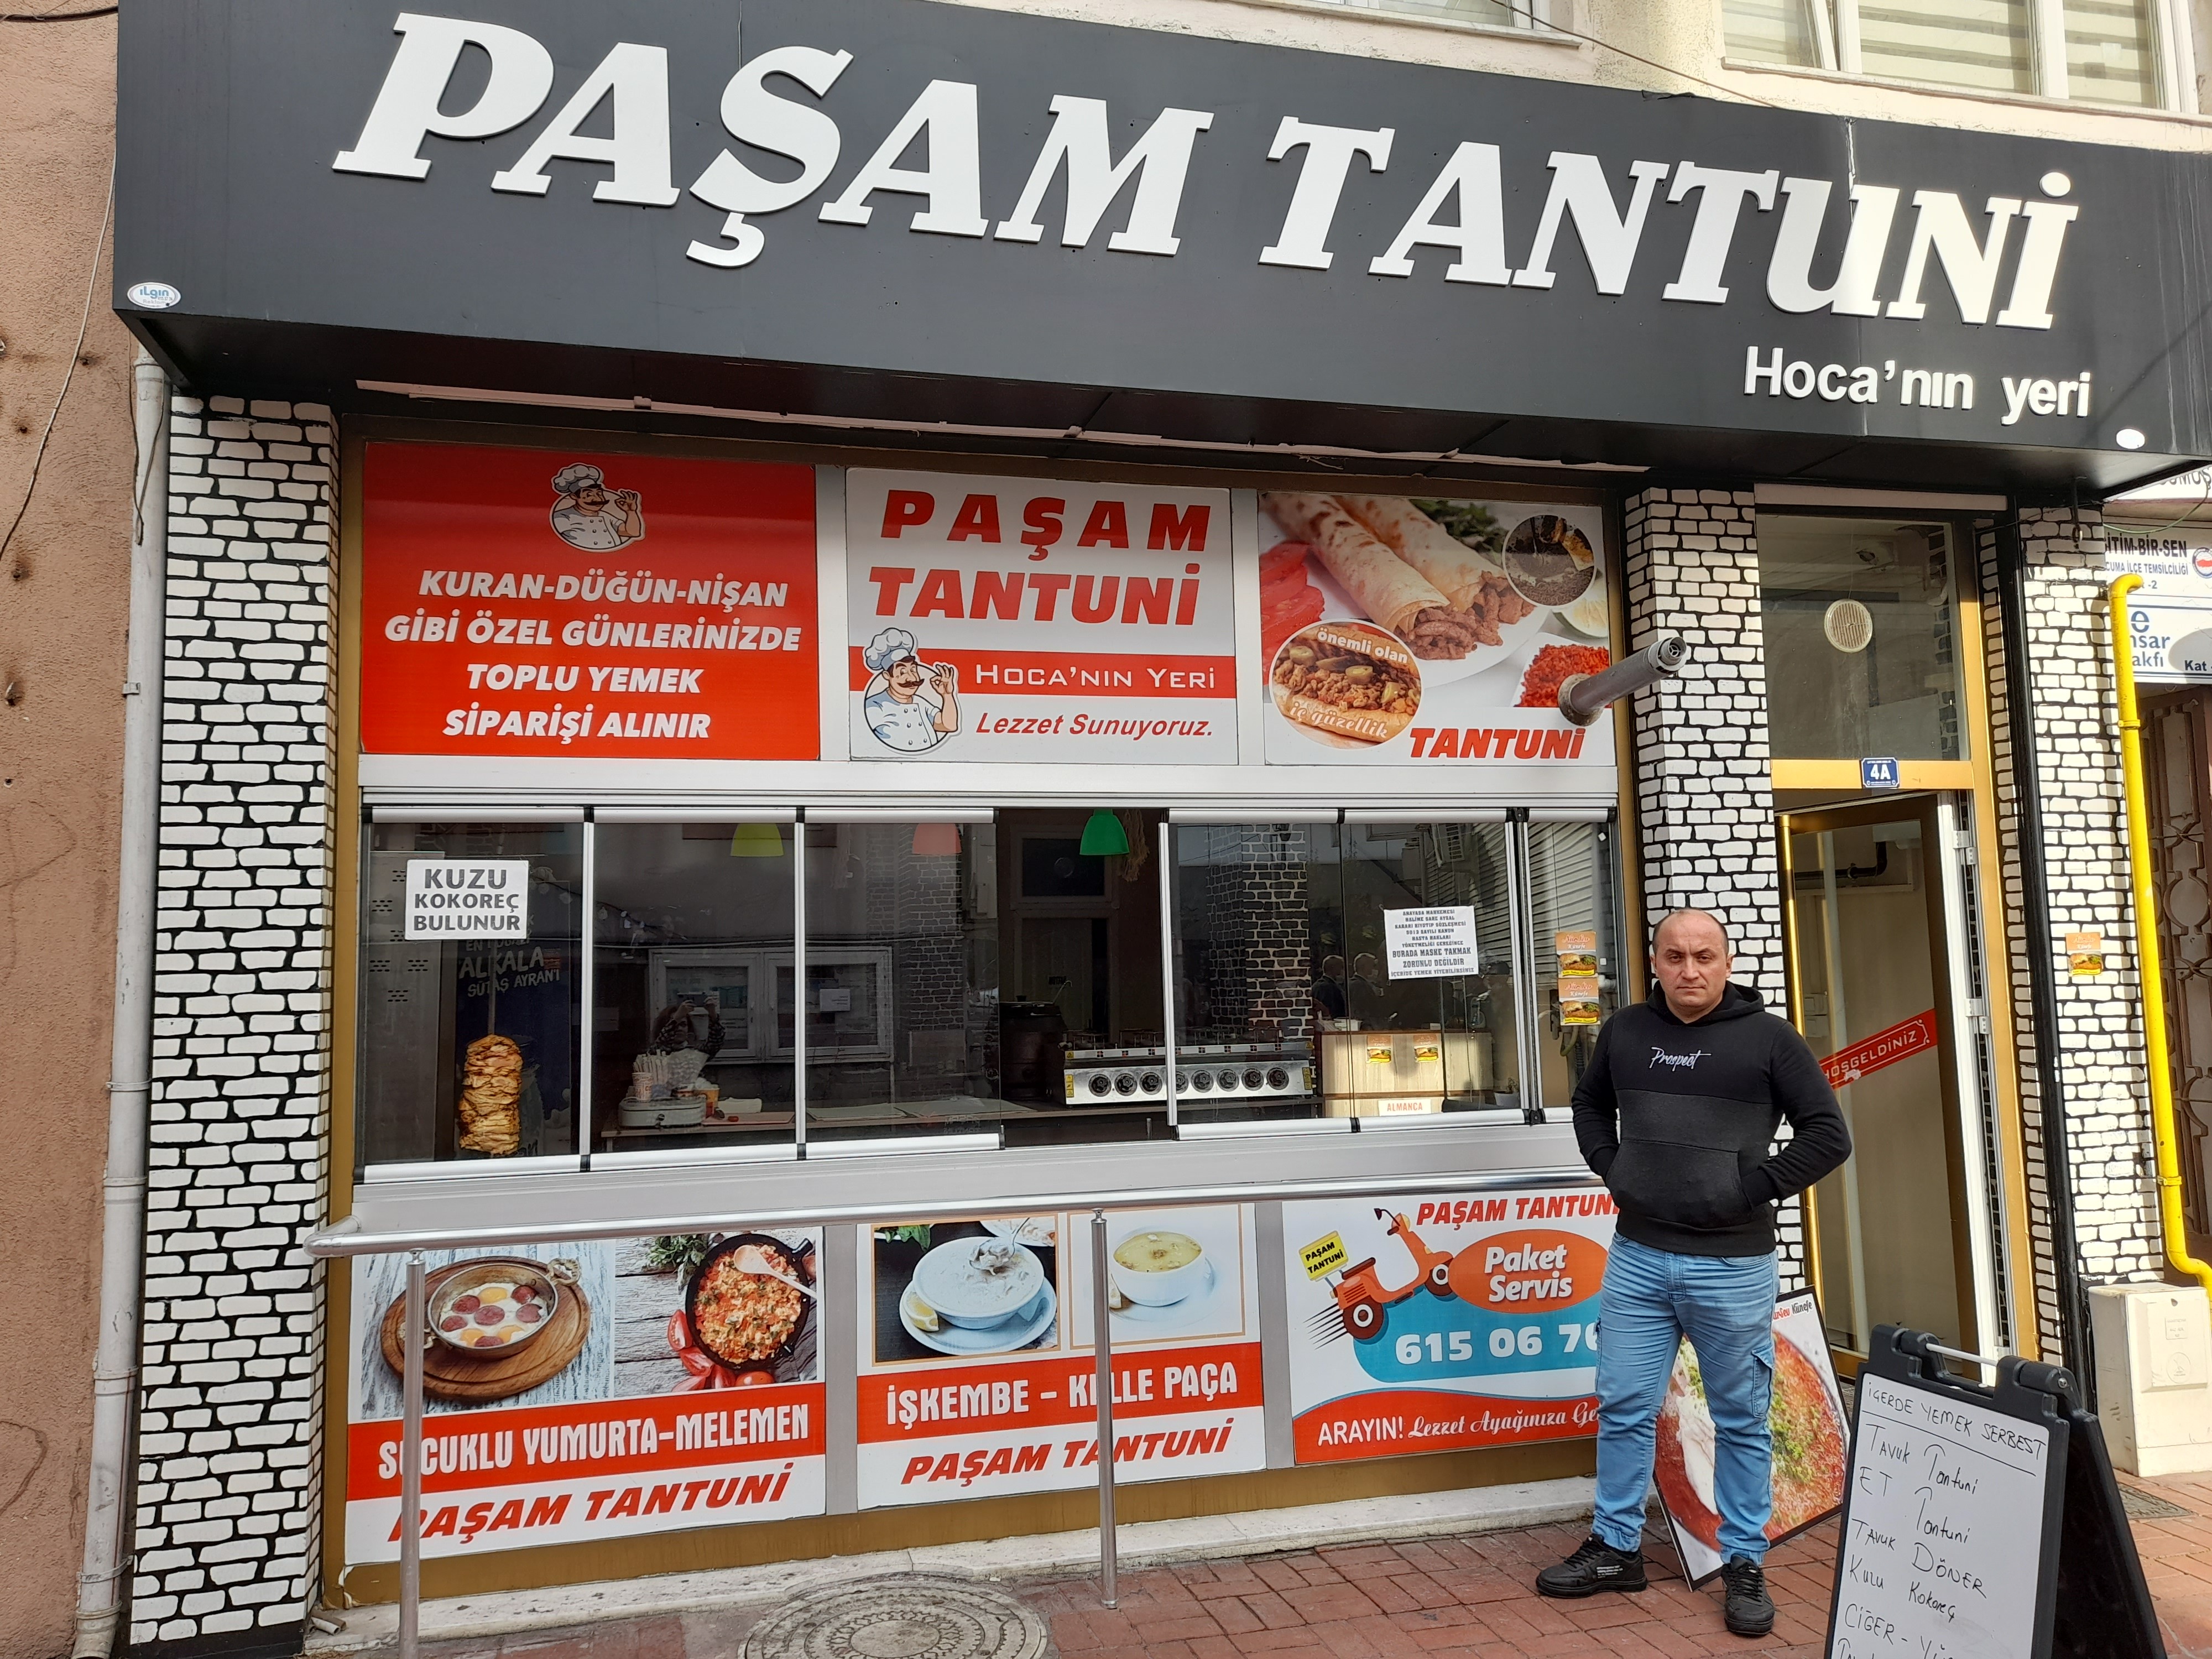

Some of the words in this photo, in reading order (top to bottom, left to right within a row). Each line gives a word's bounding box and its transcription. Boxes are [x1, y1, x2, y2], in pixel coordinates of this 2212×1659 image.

[332, 11, 1215, 268] PAŞAM
[1258, 115, 2080, 330] TANTUNİ
[1743, 345, 1974, 411] Hoca'nın
[2000, 371, 2092, 427] yeri
[880, 489, 1211, 561] PAŞAM
[2106, 532, 2188, 558] İTİM-BİR-SEN
[2127, 560, 2142, 575] İLÇE
[419, 567, 788, 613] KURAN-DÜĞÜN-NİŞAN
[869, 563, 1200, 625] TANTUNİ
[385, 608, 460, 644] GİBİ
[466, 609, 553, 646] ÖZEL
[561, 614, 802, 651] GÜNLERİNİZDE
[1317, 627, 1372, 656] önemli
[1373, 643, 1408, 664] olan
[466, 664, 579, 692] TOPLU
[588, 666, 705, 694] YEMEK
[2184, 660, 2207, 671] Kat
[442, 701, 593, 745] SİPARİŞİ
[597, 712, 711, 739] ALINIR
[976, 712, 1063, 734] Lezzet
[1070, 713, 1213, 742] Sunuyoruz.
[1290, 701, 1308, 723] iç
[1310, 706, 1388, 739] güzellik
[1410, 727, 1585, 759] TANTUNİ
[1870, 764, 1891, 780] 4A
[424, 868, 507, 889] KUZU
[415, 893, 519, 914] KOKOREÇ
[414, 915, 520, 931] BULUNUR
[1392, 950, 1418, 958] BURADA
[1403, 959, 1432, 968] ZORUNLU
[1434, 957, 1464, 966] DEĞİLDİR
[1386, 1101, 1423, 1112] ALMANCA
[1416, 1199, 1508, 1230] PAŞAM
[1515, 1193, 1619, 1220] TANTUN
[1306, 1241, 1335, 1261] PAŞAM
[1307, 1249, 1344, 1274] TANTUNİ
[1484, 1243, 1567, 1274] Paket
[1489, 1271, 1573, 1302] Servis
[1395, 1331, 1473, 1365] 615
[1489, 1326, 1542, 1358] 06
[887, 1380, 1029, 1431] İŞKEMBE
[1164, 1361, 1237, 1402] PAÇA
[379, 1431, 513, 1480] SCUKLU
[523, 1403, 808, 1465] YUMURTA-MELEMEN
[1318, 1416, 1404, 1447] ARAYIN!
[1408, 1413, 1465, 1438] Lezzet
[1470, 1410, 1566, 1435] Ayağınıza
[1921, 1402, 1973, 1437] YEMEK
[1981, 1423, 2047, 1460] SERBEST
[901, 1443, 1052, 1487] PAŞAM
[1860, 1466, 1893, 1498] ET
[585, 1462, 795, 1522] TANTUNİ
[1911, 1542, 1987, 1599] DÖNER
